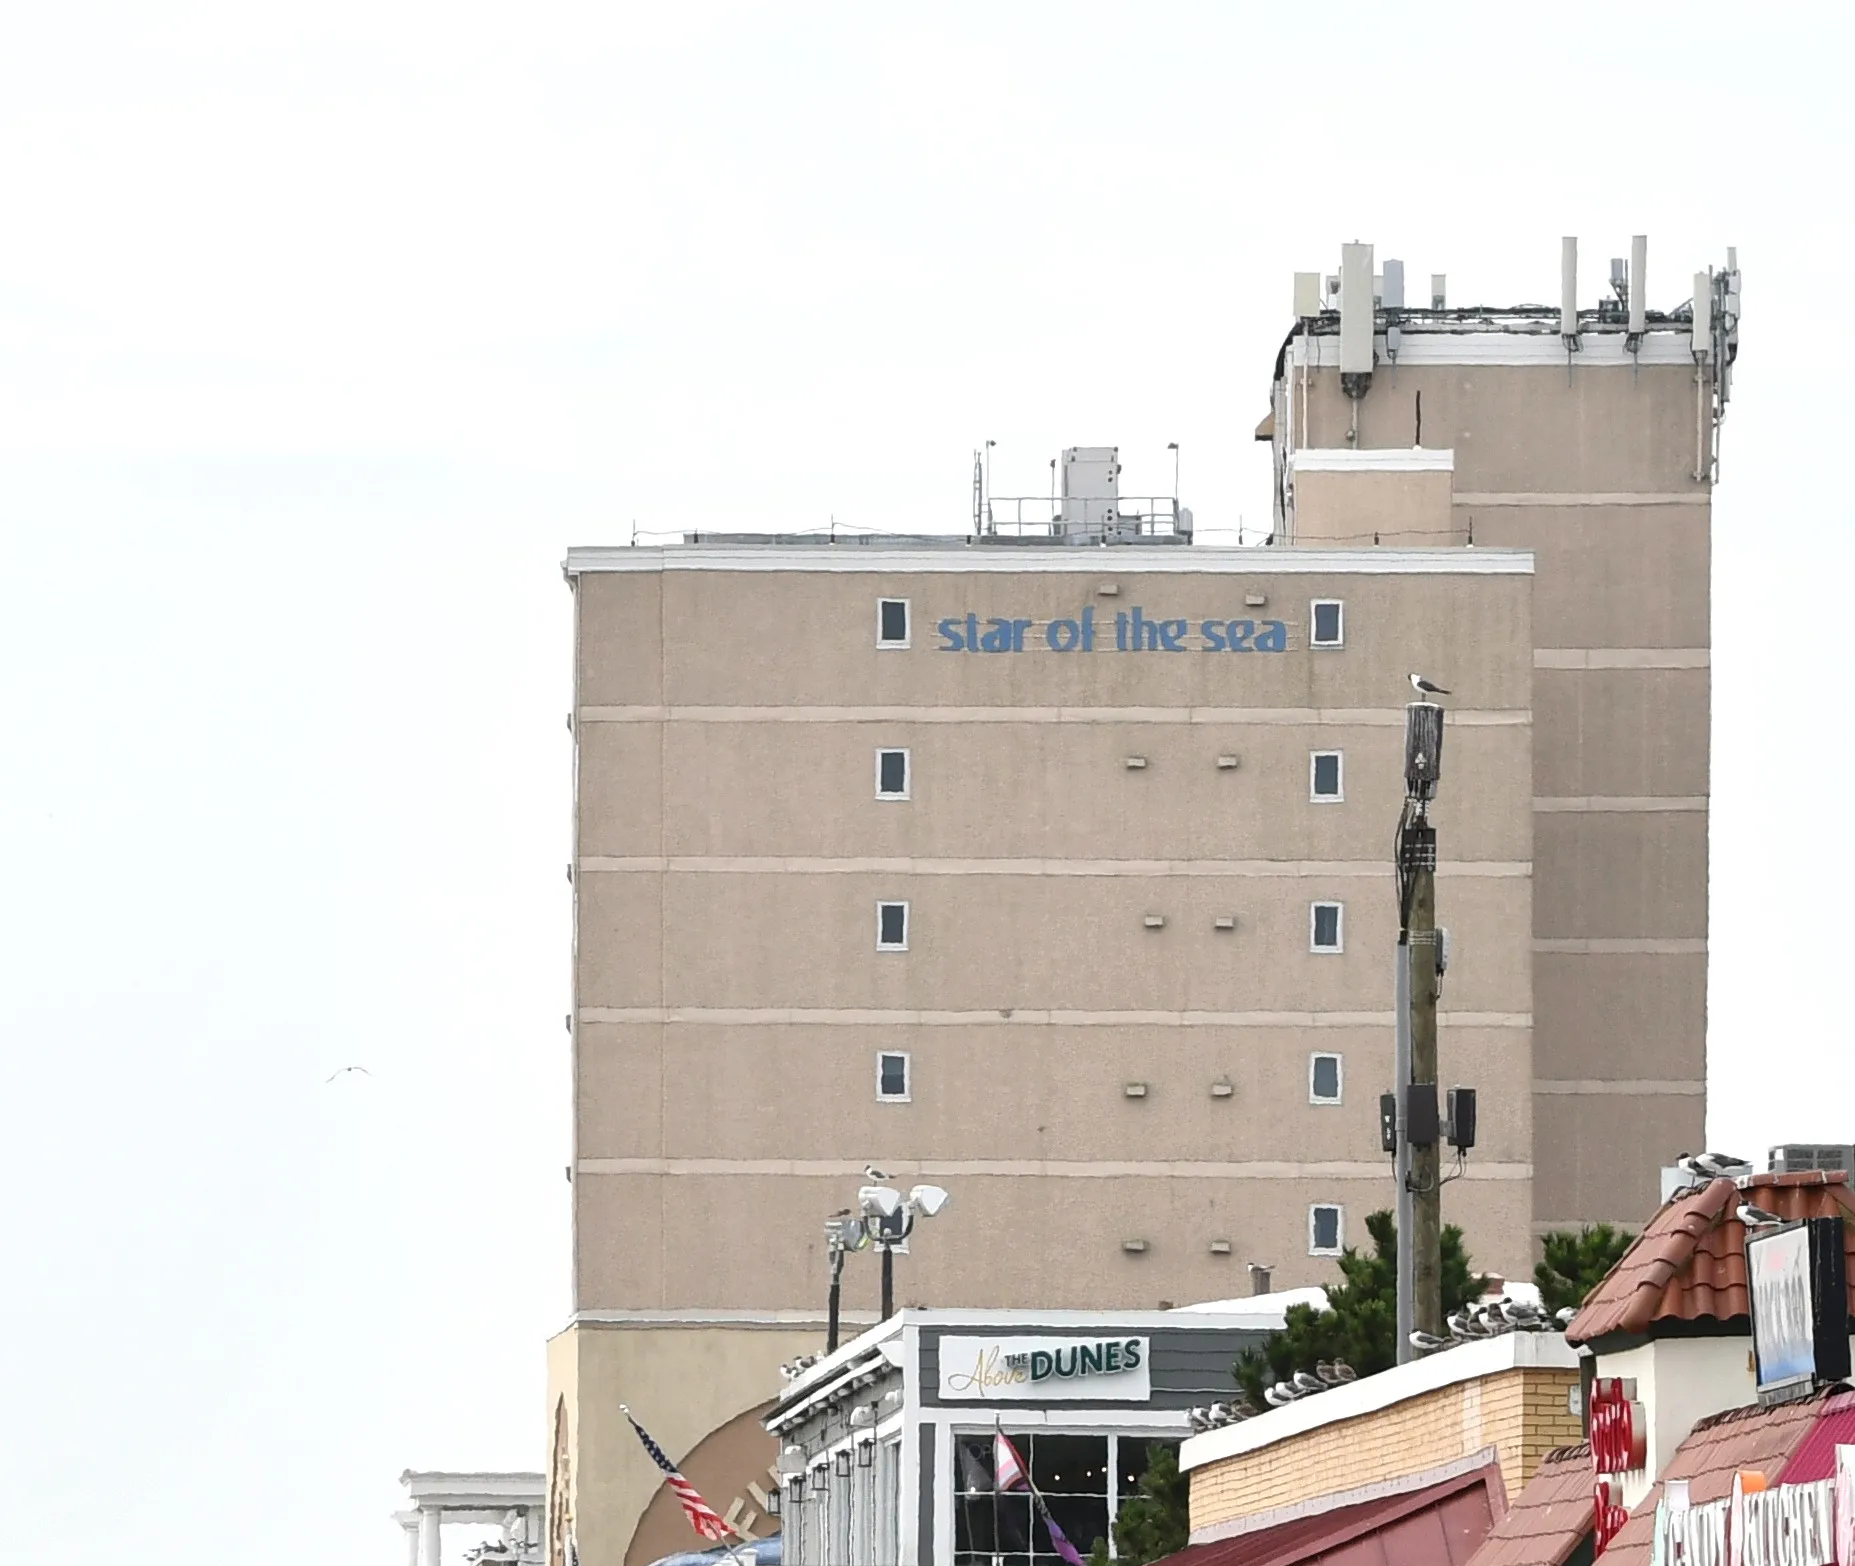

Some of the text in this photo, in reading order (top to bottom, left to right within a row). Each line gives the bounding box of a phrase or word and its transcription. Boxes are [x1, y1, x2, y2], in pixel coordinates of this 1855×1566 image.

[938, 606, 1288, 653] star of the sea
[948, 1338, 1142, 1398] Above THE DUNES
